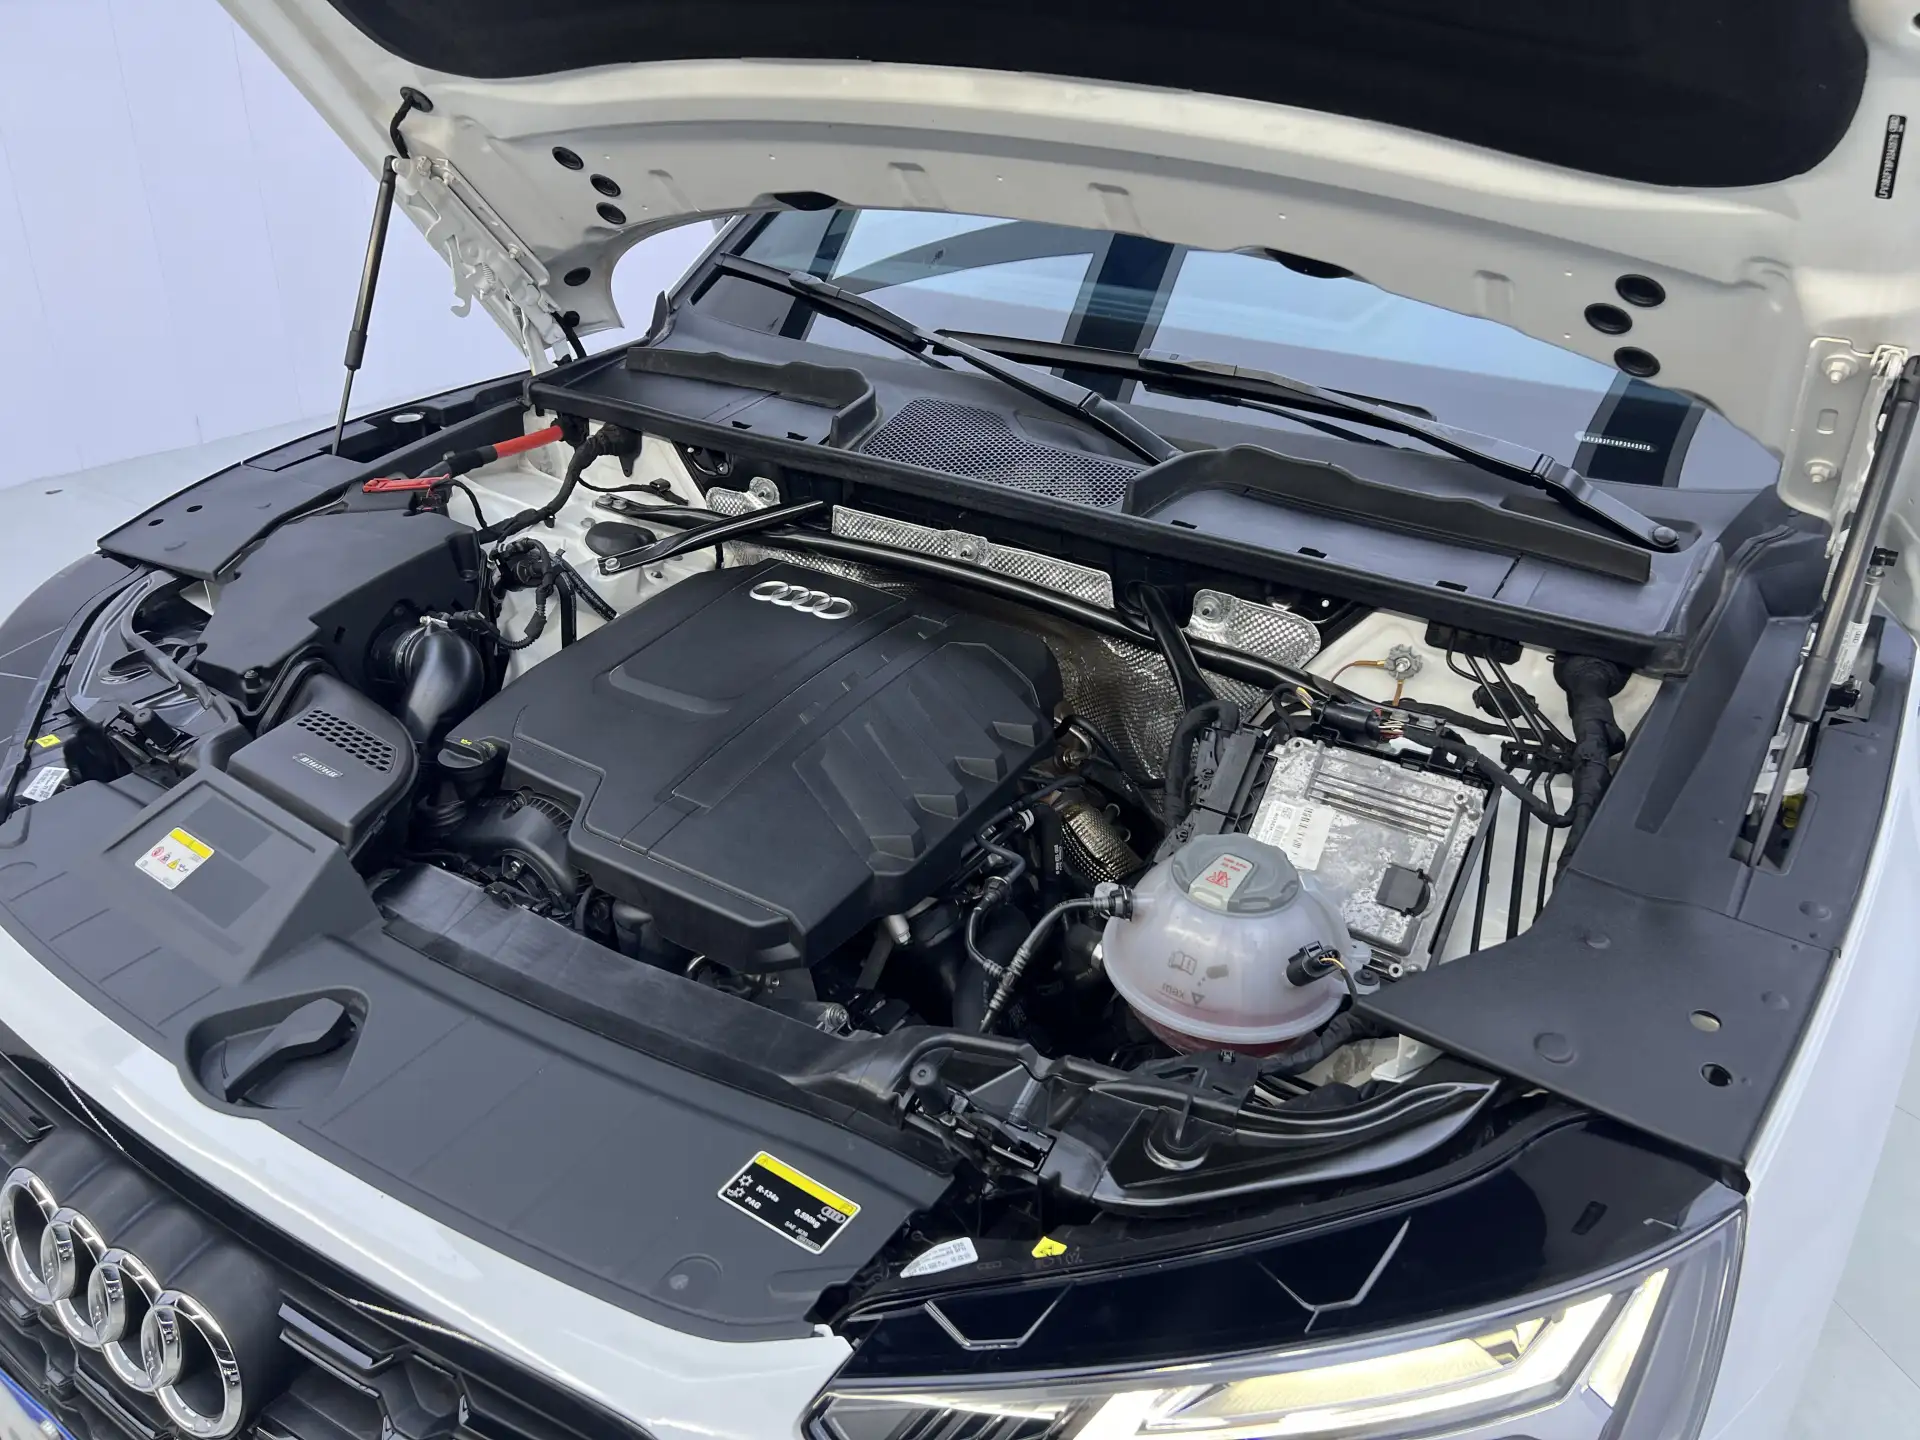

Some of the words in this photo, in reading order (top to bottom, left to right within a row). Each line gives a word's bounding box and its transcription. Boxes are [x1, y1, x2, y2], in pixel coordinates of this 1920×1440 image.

[1162, 983, 1185, 999] max
[755, 1184, 780, 1203] R-134a
[744, 1196, 762, 1210] PAG
